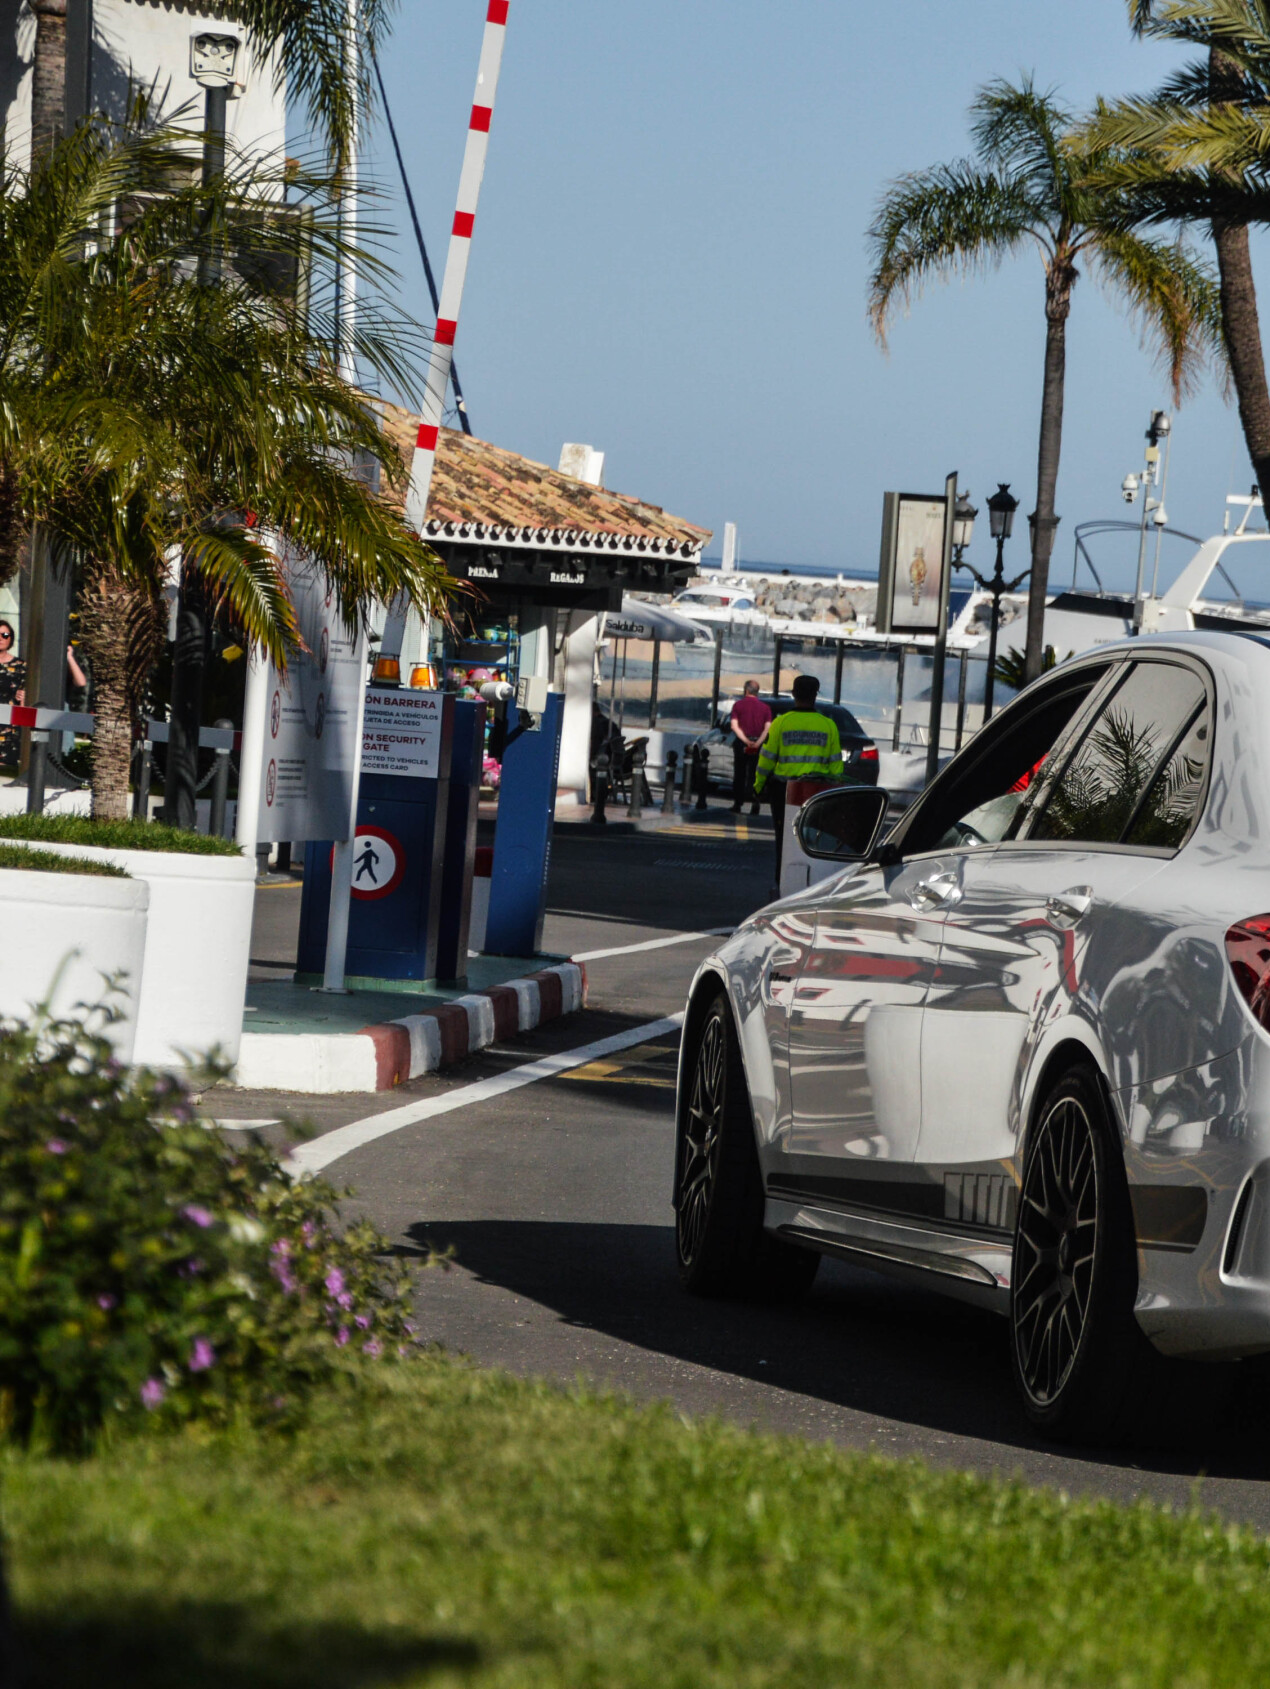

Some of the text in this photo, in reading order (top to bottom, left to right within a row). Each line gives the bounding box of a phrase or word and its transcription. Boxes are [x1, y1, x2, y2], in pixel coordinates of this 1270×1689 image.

[605, 618, 645, 634] Salduba
[384, 697, 436, 709] BARRERA
[402, 711, 439, 721] VEHÍCULOS
[394, 719, 421, 727] ACCESO
[376, 733, 426, 745] SECURITY
[363, 742, 390, 752] GATE
[362, 762, 389, 770] ACCESS
[397, 757, 428, 766] VEHICLES
